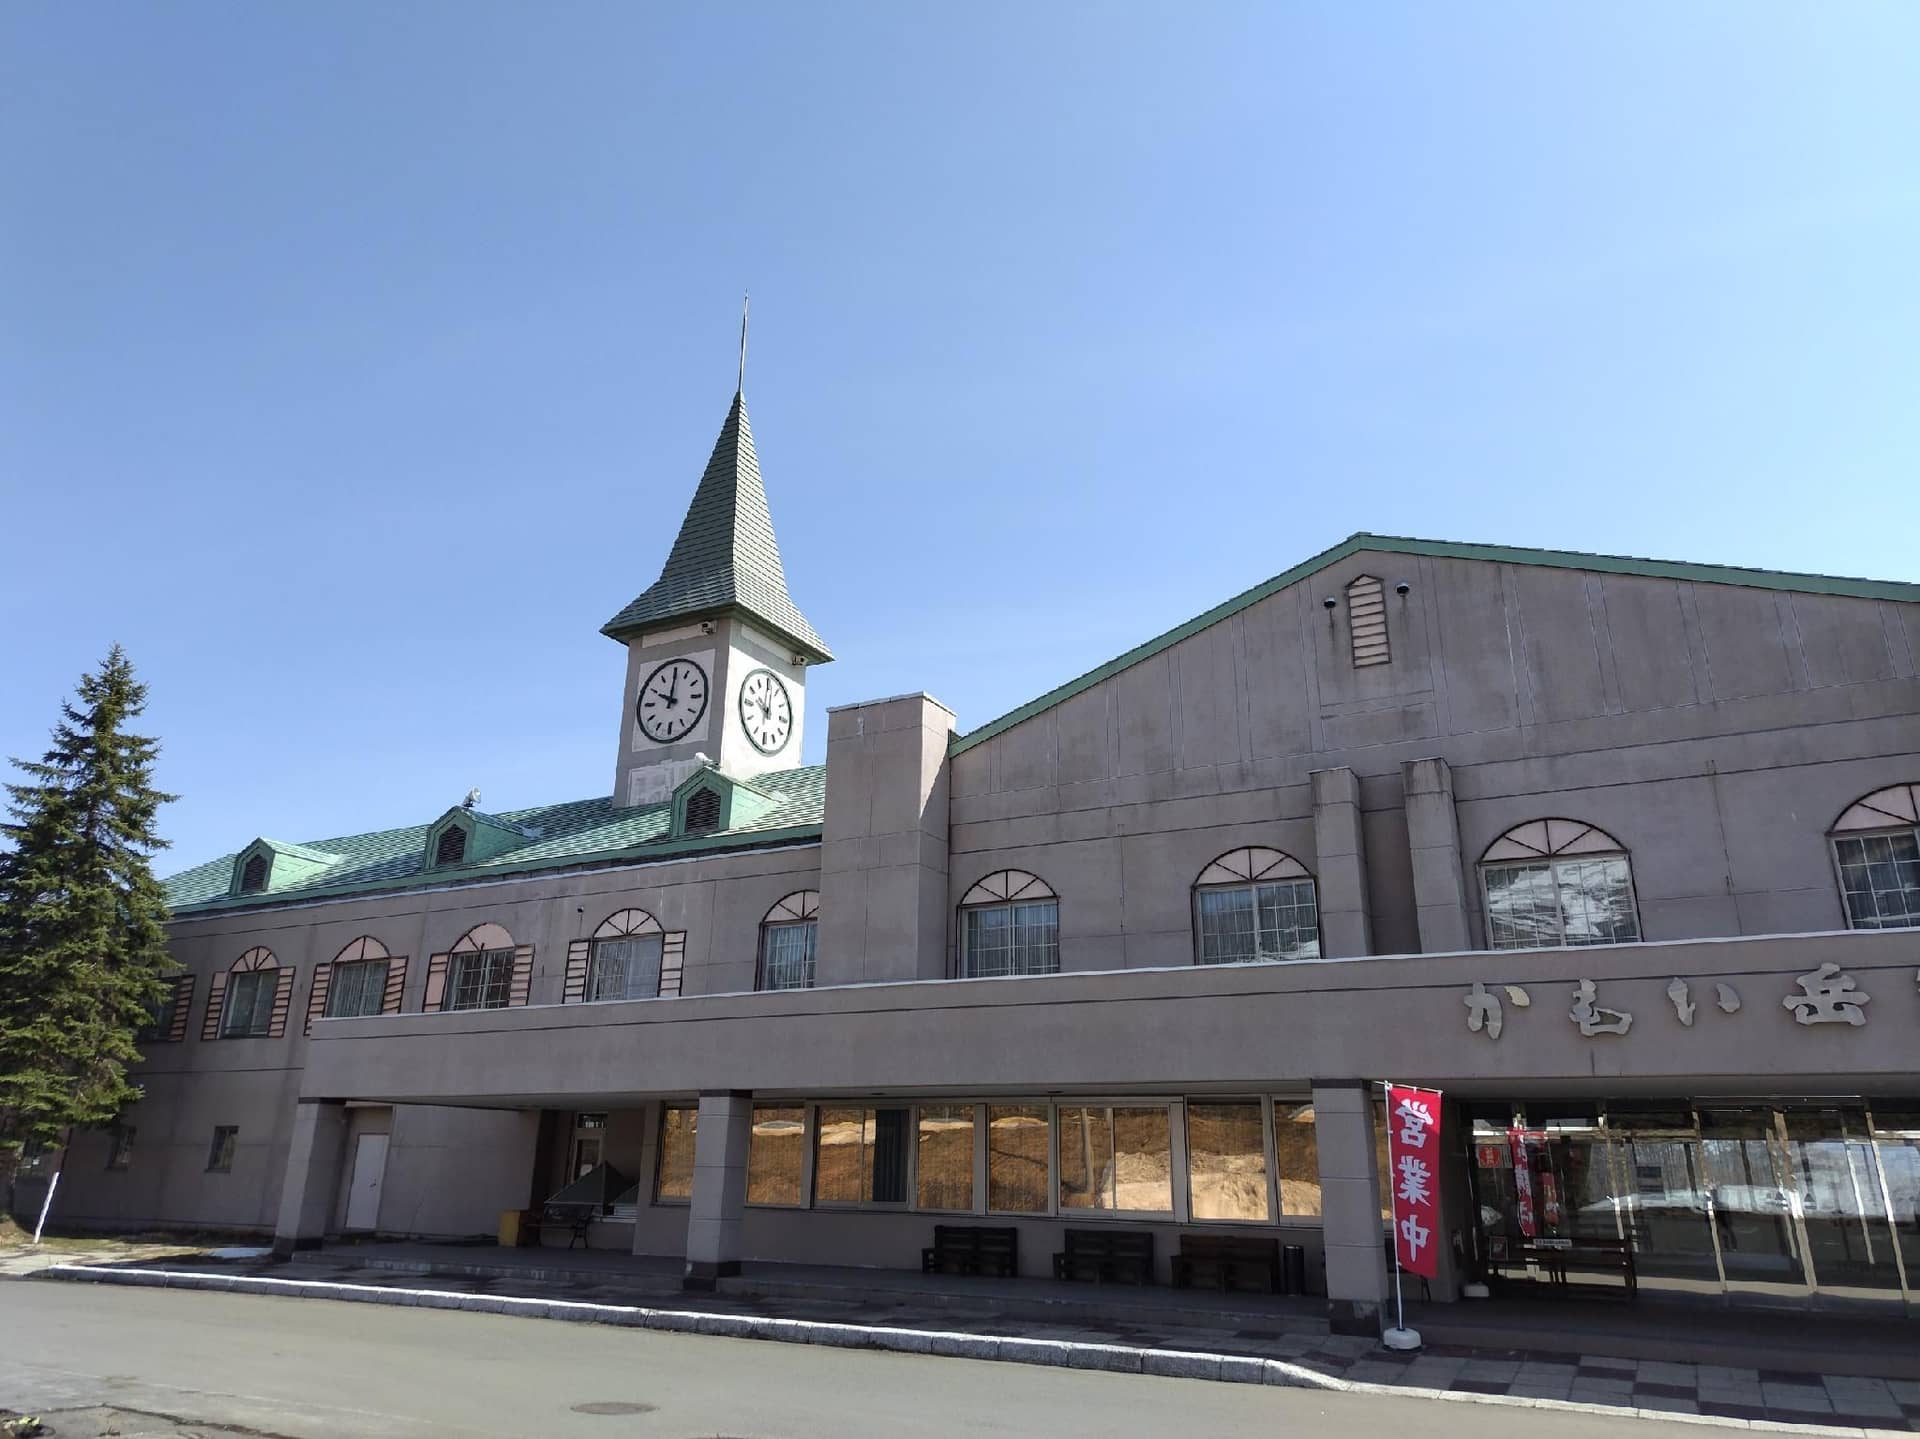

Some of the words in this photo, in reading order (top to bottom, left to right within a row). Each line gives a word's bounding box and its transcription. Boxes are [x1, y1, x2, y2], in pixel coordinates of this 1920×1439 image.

[1463, 962, 1920, 1040] かむい岳
[1395, 1098, 1434, 1262] 営業中
